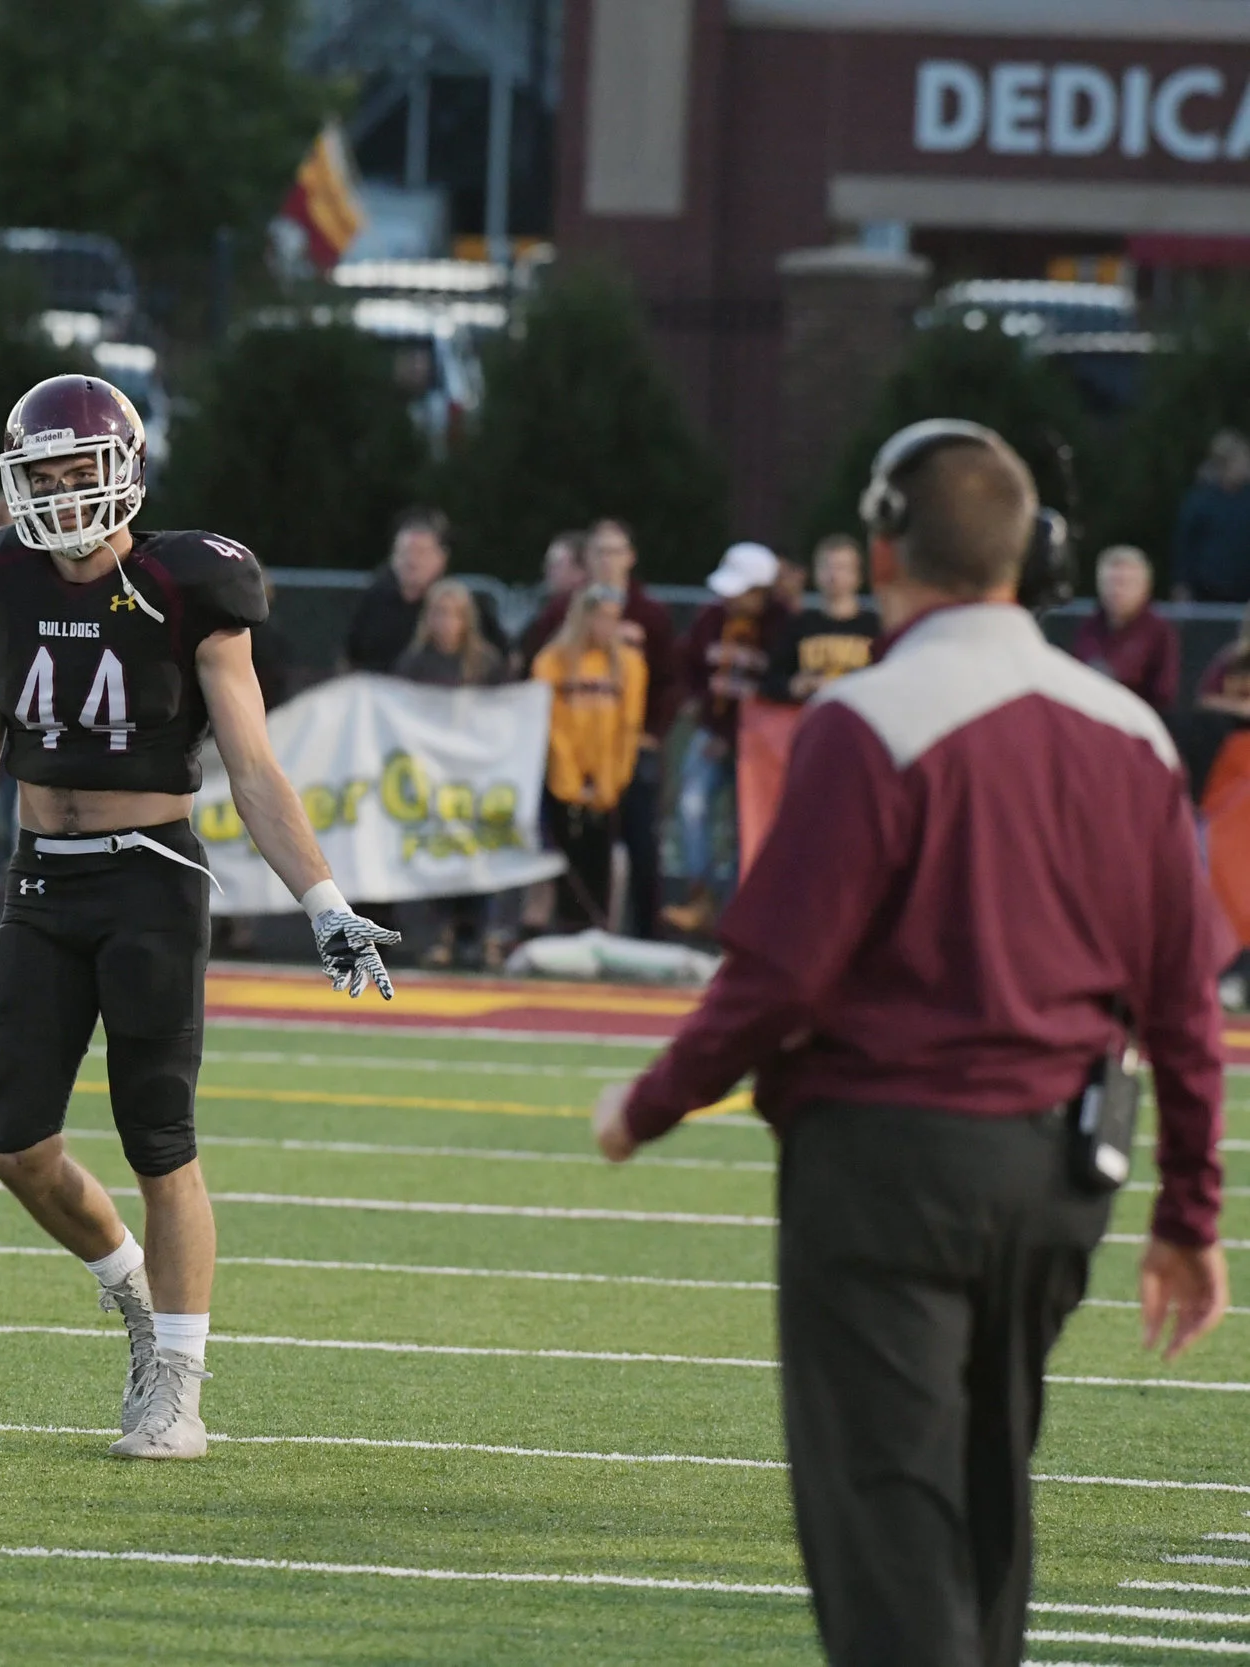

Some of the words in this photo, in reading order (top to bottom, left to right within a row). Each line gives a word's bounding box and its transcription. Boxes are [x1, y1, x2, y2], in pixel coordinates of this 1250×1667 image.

[34, 431, 63, 443] Riddell
[38, 620, 100, 638] BULLDOGS
[14, 645, 137, 751] 44
